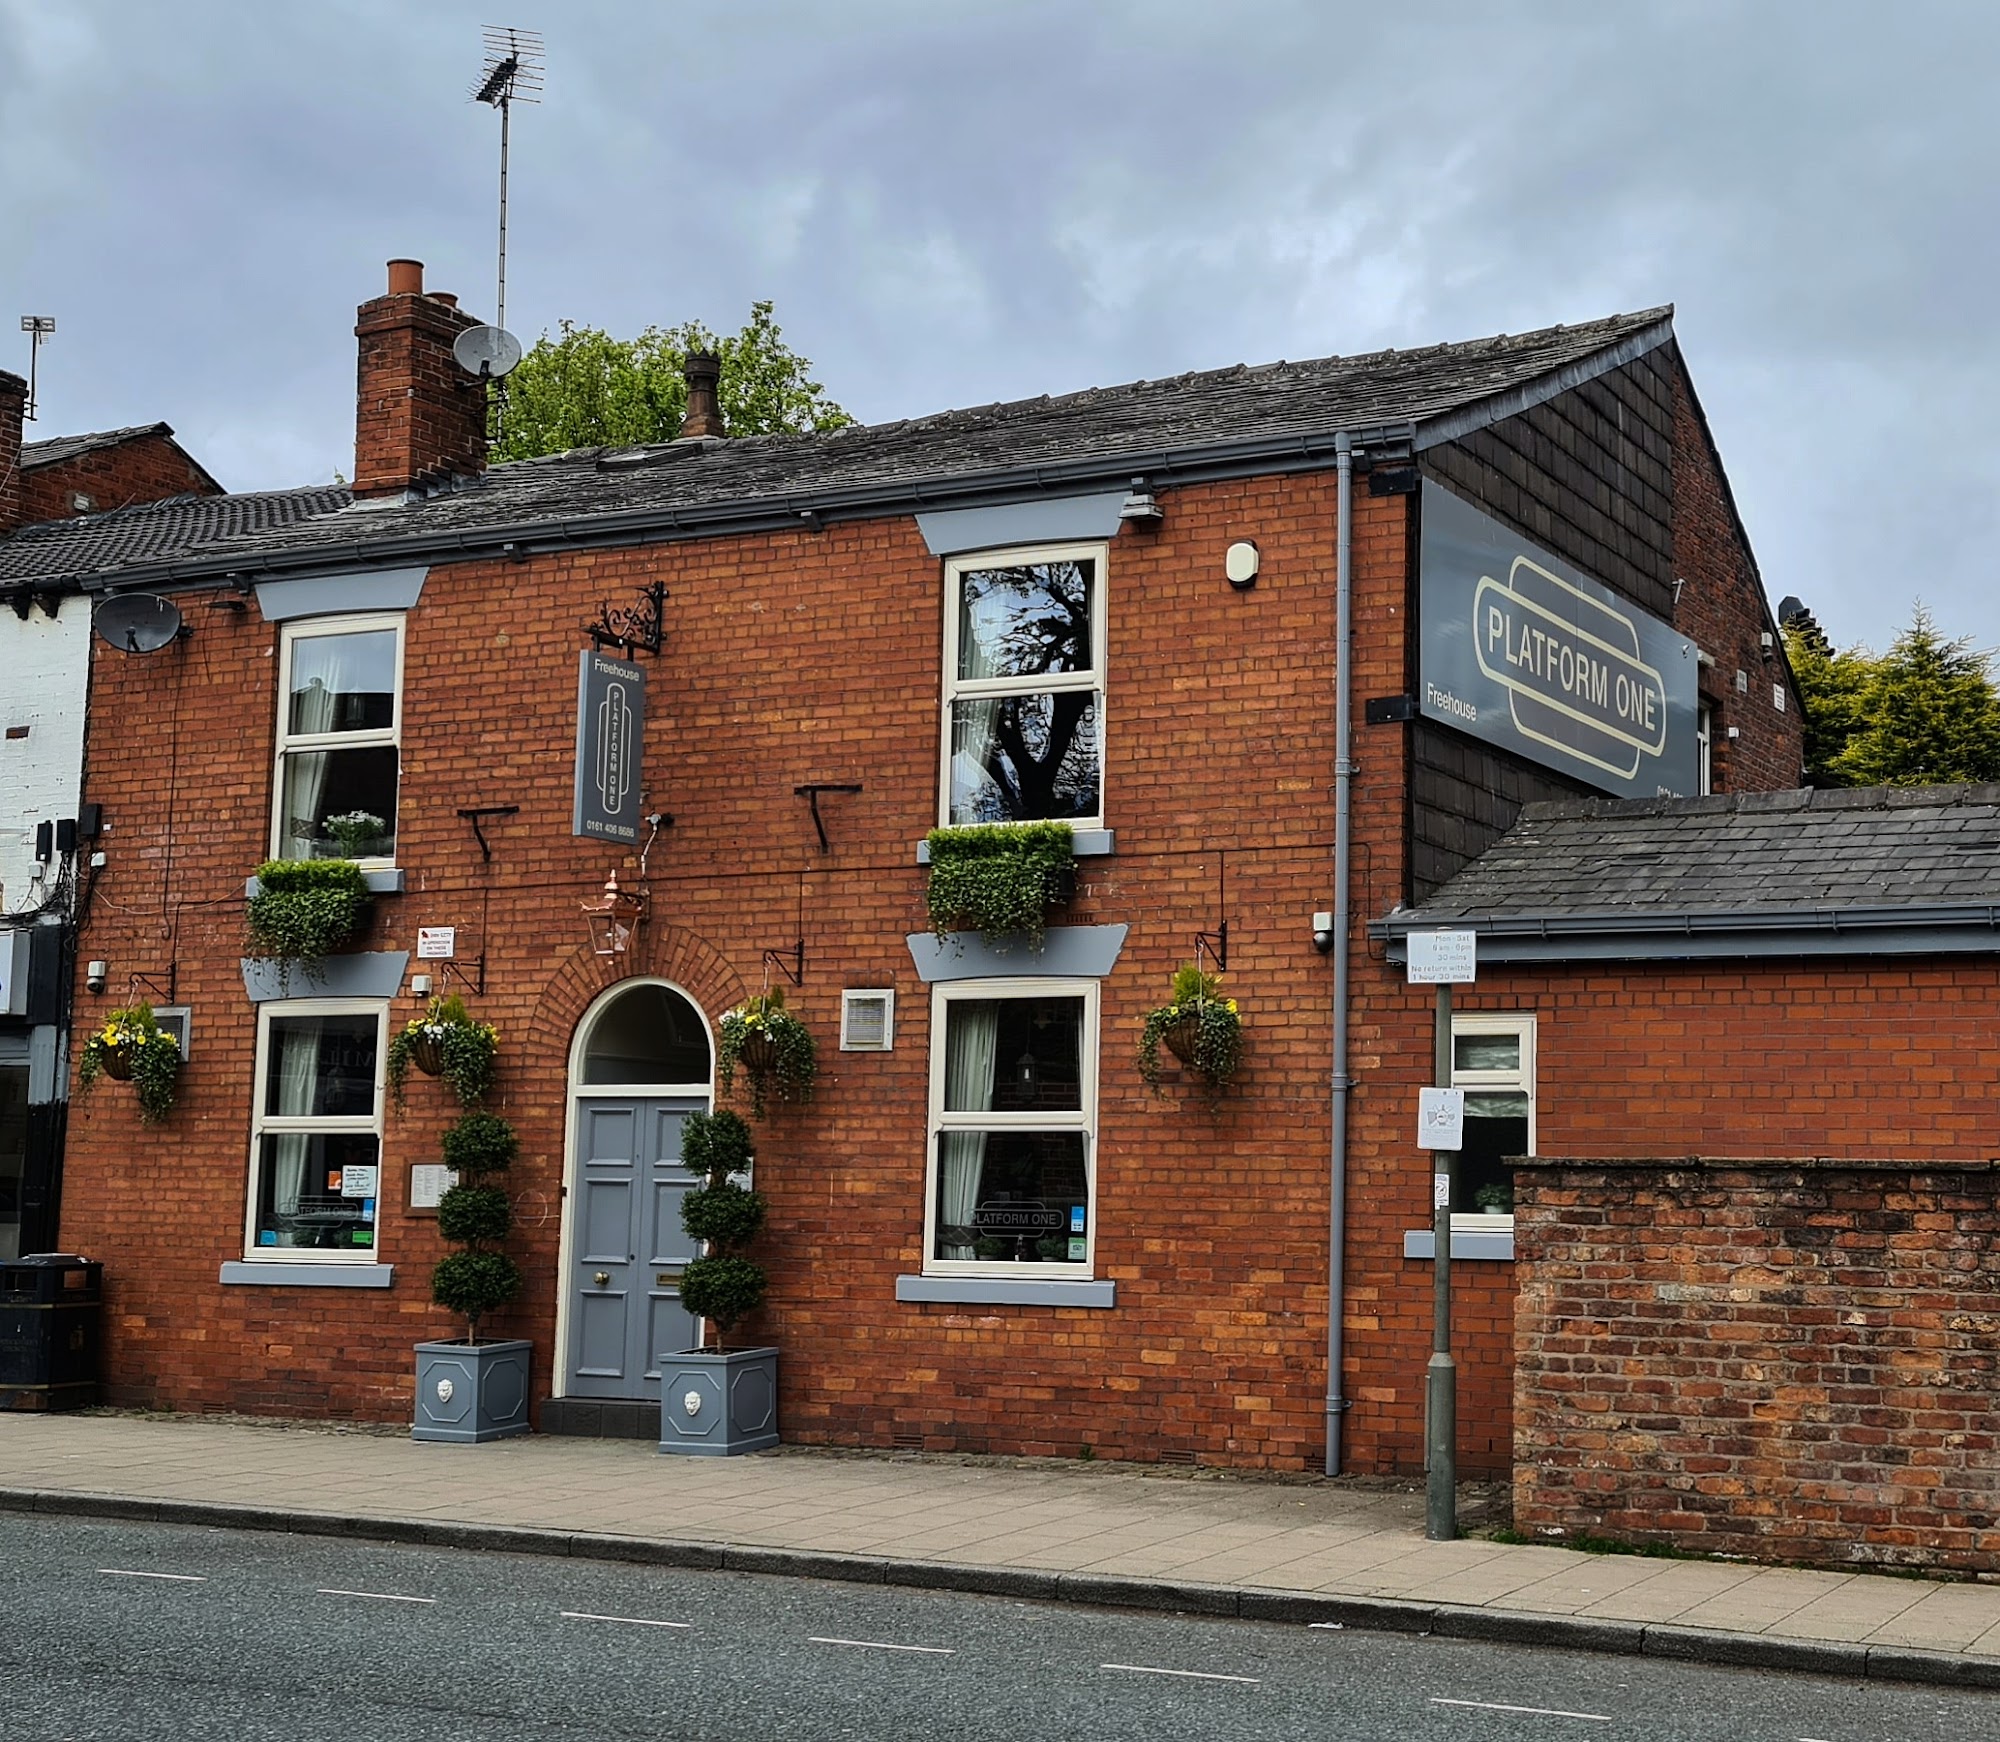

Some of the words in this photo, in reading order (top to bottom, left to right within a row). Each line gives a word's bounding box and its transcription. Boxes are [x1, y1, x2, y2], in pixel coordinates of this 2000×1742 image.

[595, 658, 640, 682] Freehouse
[1488, 605, 1608, 709] PLATFORM
[1615, 673, 1656, 732] ONE
[1427, 681, 1477, 722] Freehouse
[609, 691, 620, 773] PLATFORM
[609, 775, 617, 806] ONE
[586, 819, 603, 832] 0161
[1435, 934, 1451, 942] Mon
[1456, 934, 1469, 942] Sat
[1411, 965, 1422, 973] No
[1449, 963, 1472, 972] within
[1031, 1213, 1057, 1225] ONE
